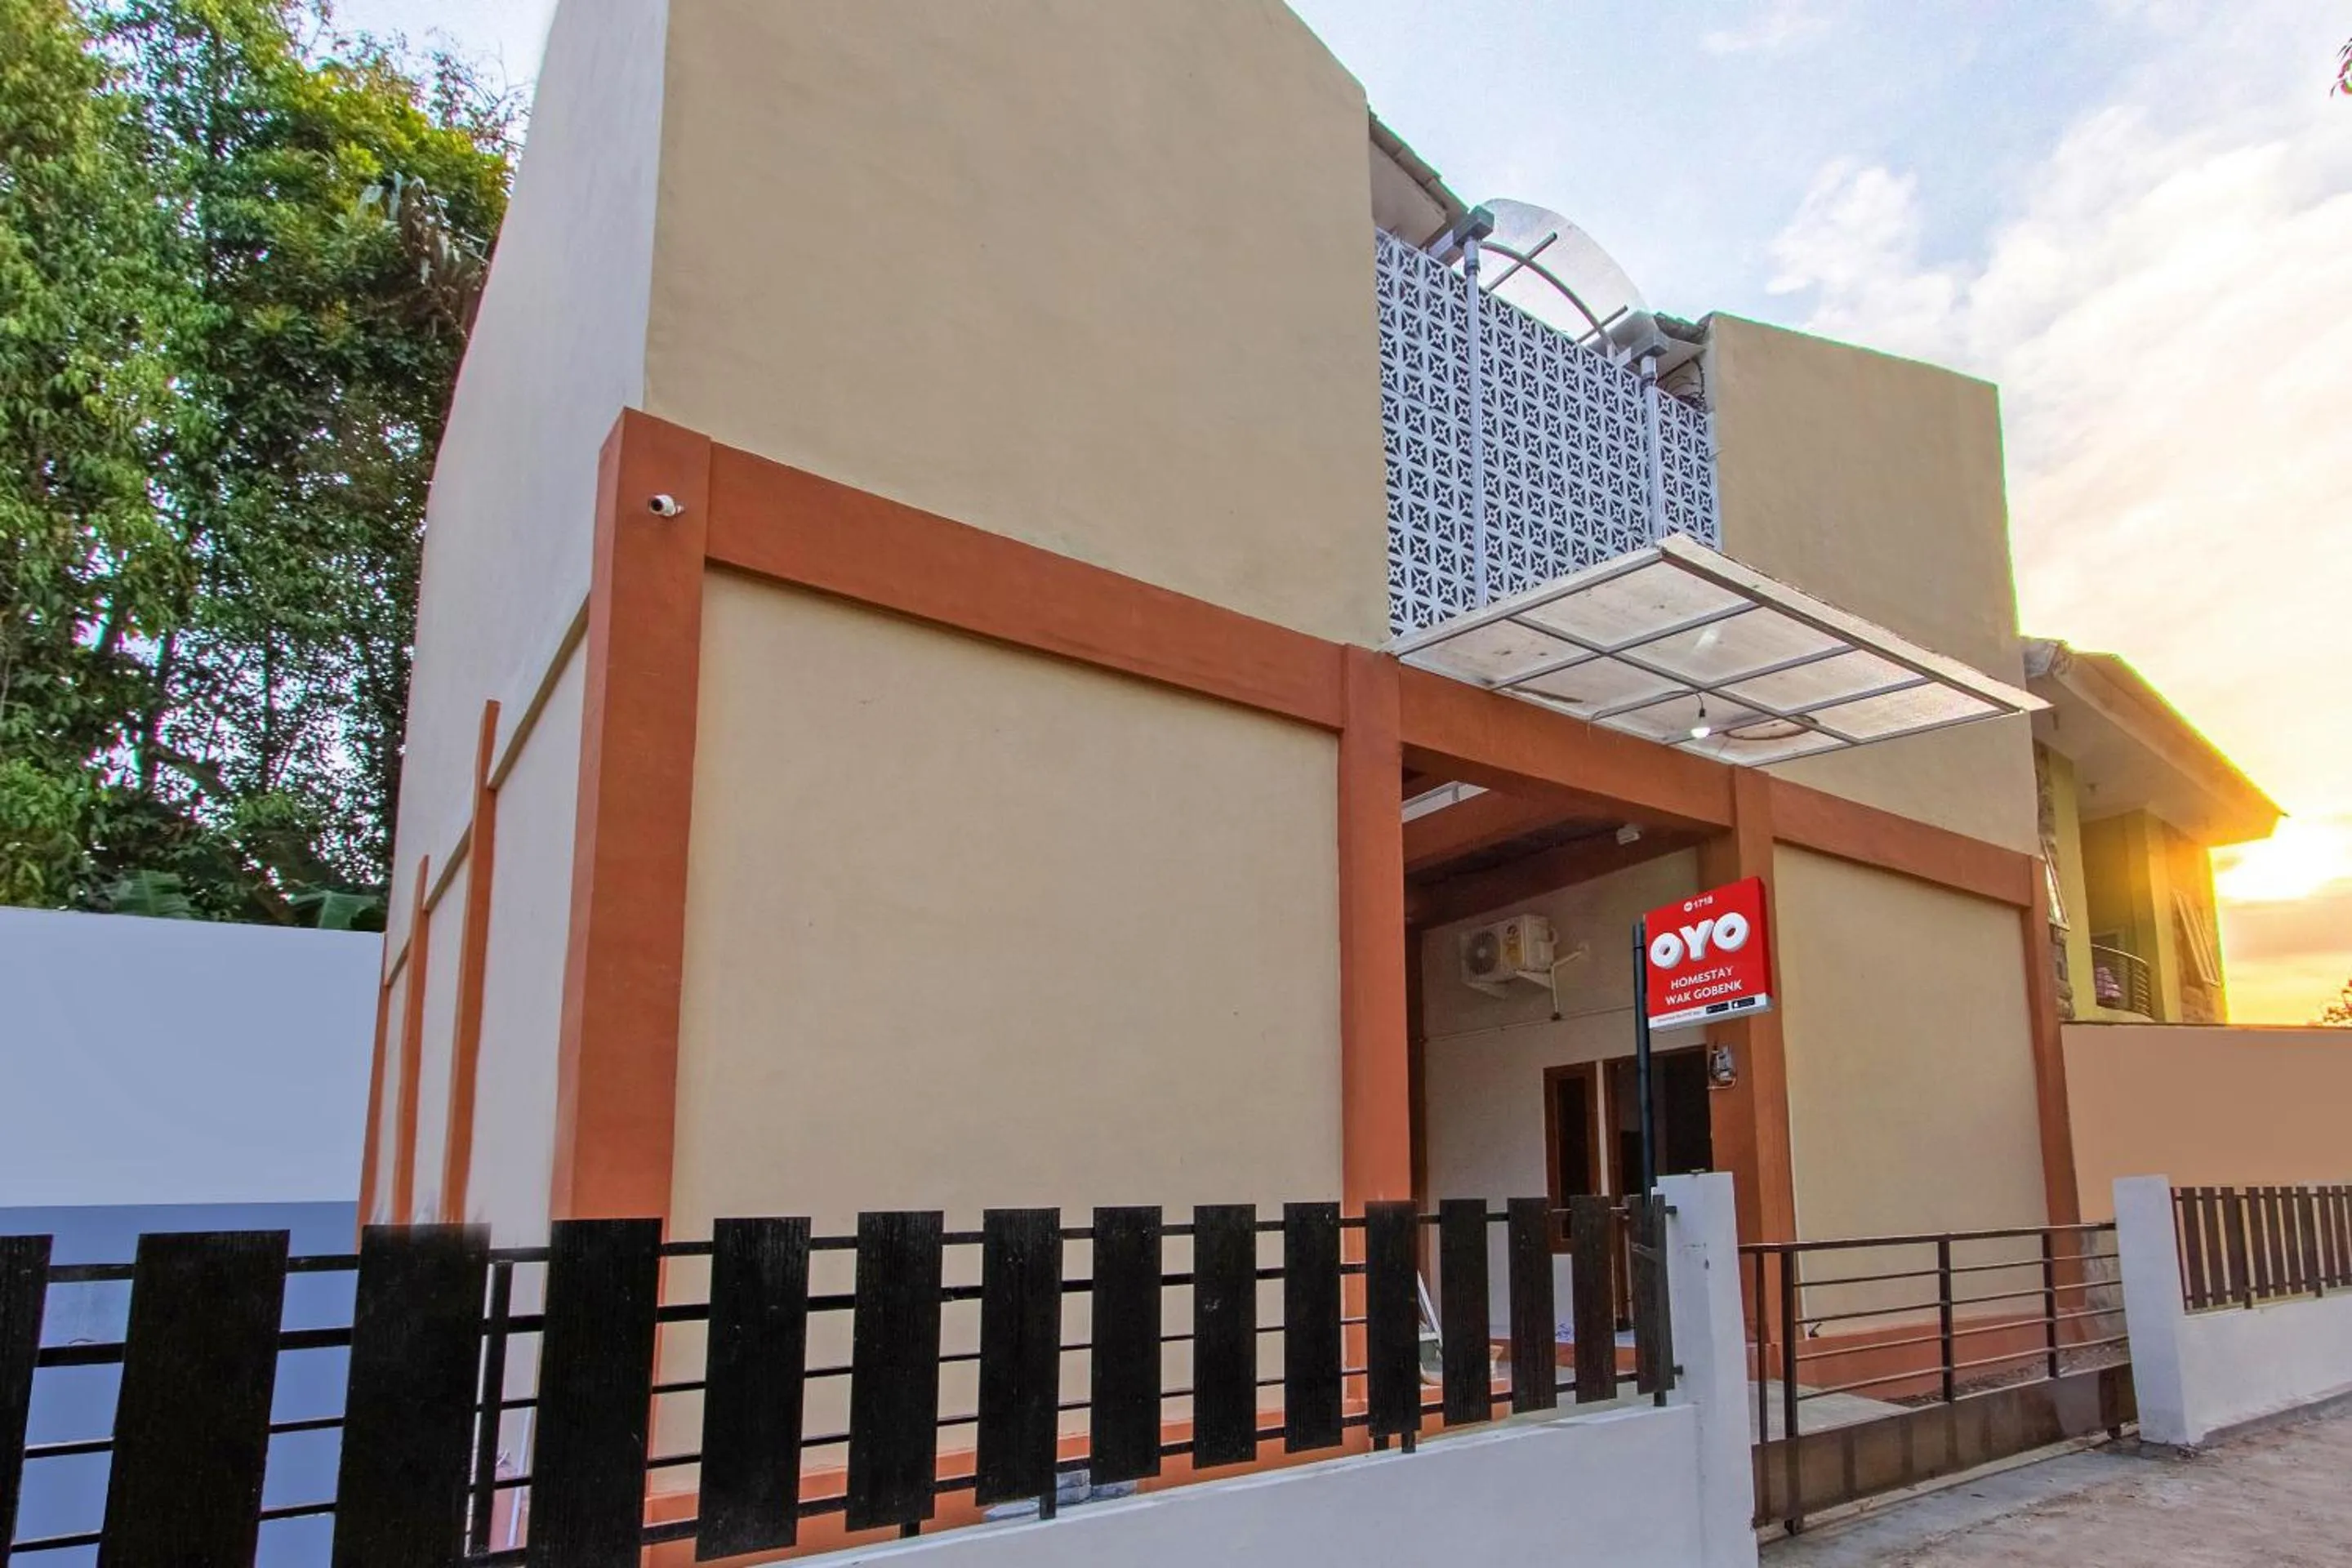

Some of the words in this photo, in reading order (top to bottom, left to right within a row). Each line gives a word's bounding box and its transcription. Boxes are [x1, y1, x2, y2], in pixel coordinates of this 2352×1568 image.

[1650, 911, 1750, 969] OYO
[1671, 965, 1734, 990] HOMESTAY
[1665, 991, 1691, 1006] WAK
[1693, 979, 1743, 1000] GOBENK
